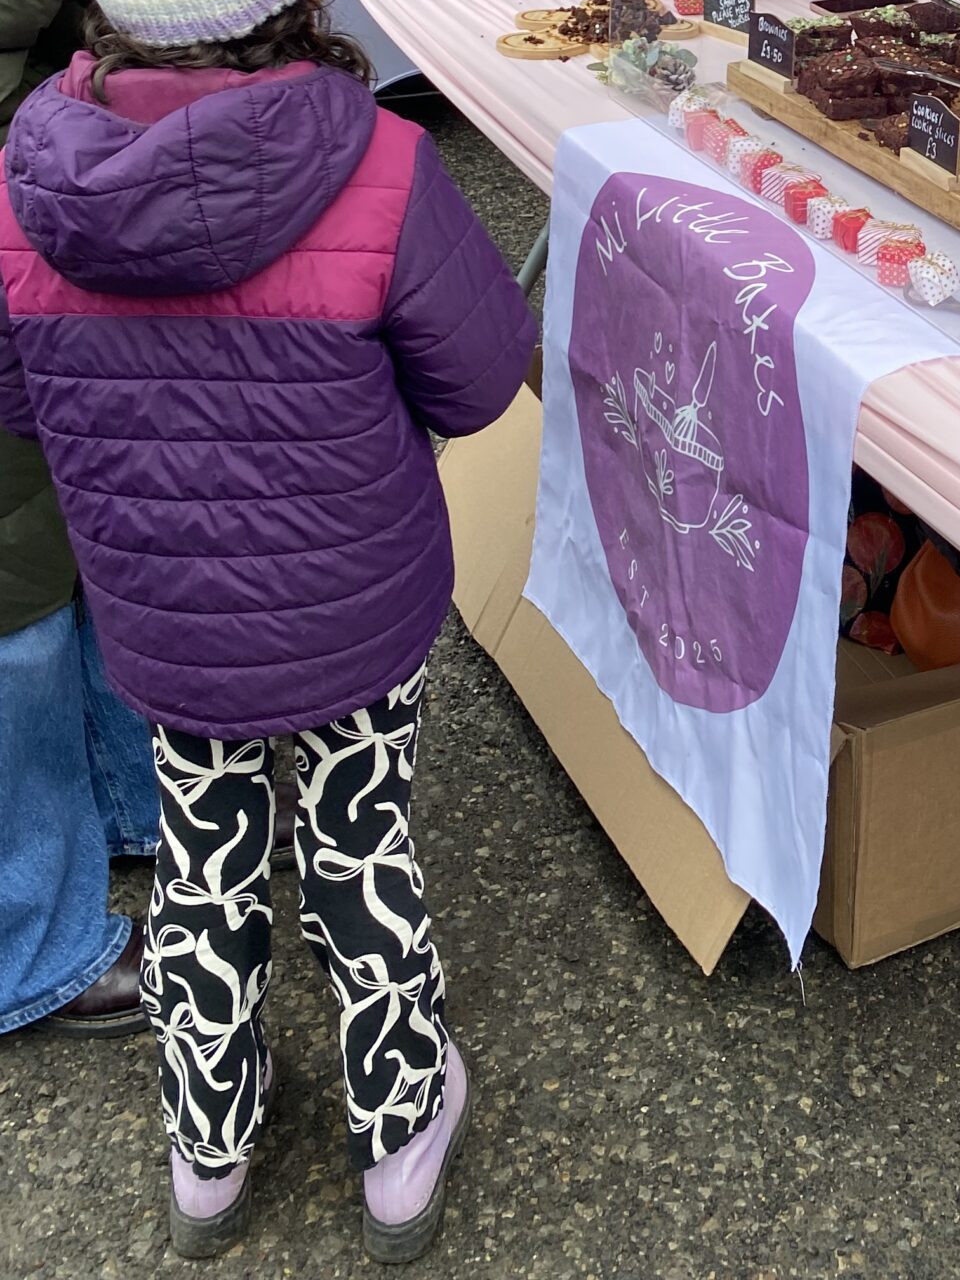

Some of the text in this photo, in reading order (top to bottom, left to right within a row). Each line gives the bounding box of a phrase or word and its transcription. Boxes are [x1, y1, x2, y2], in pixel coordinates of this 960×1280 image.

[758, 16, 788, 41] Brownies
[925, 137, 937, 160] £3
[594, 186, 796, 418] Mi Little Bakes
[618, 526, 723, 665] EST 2025
